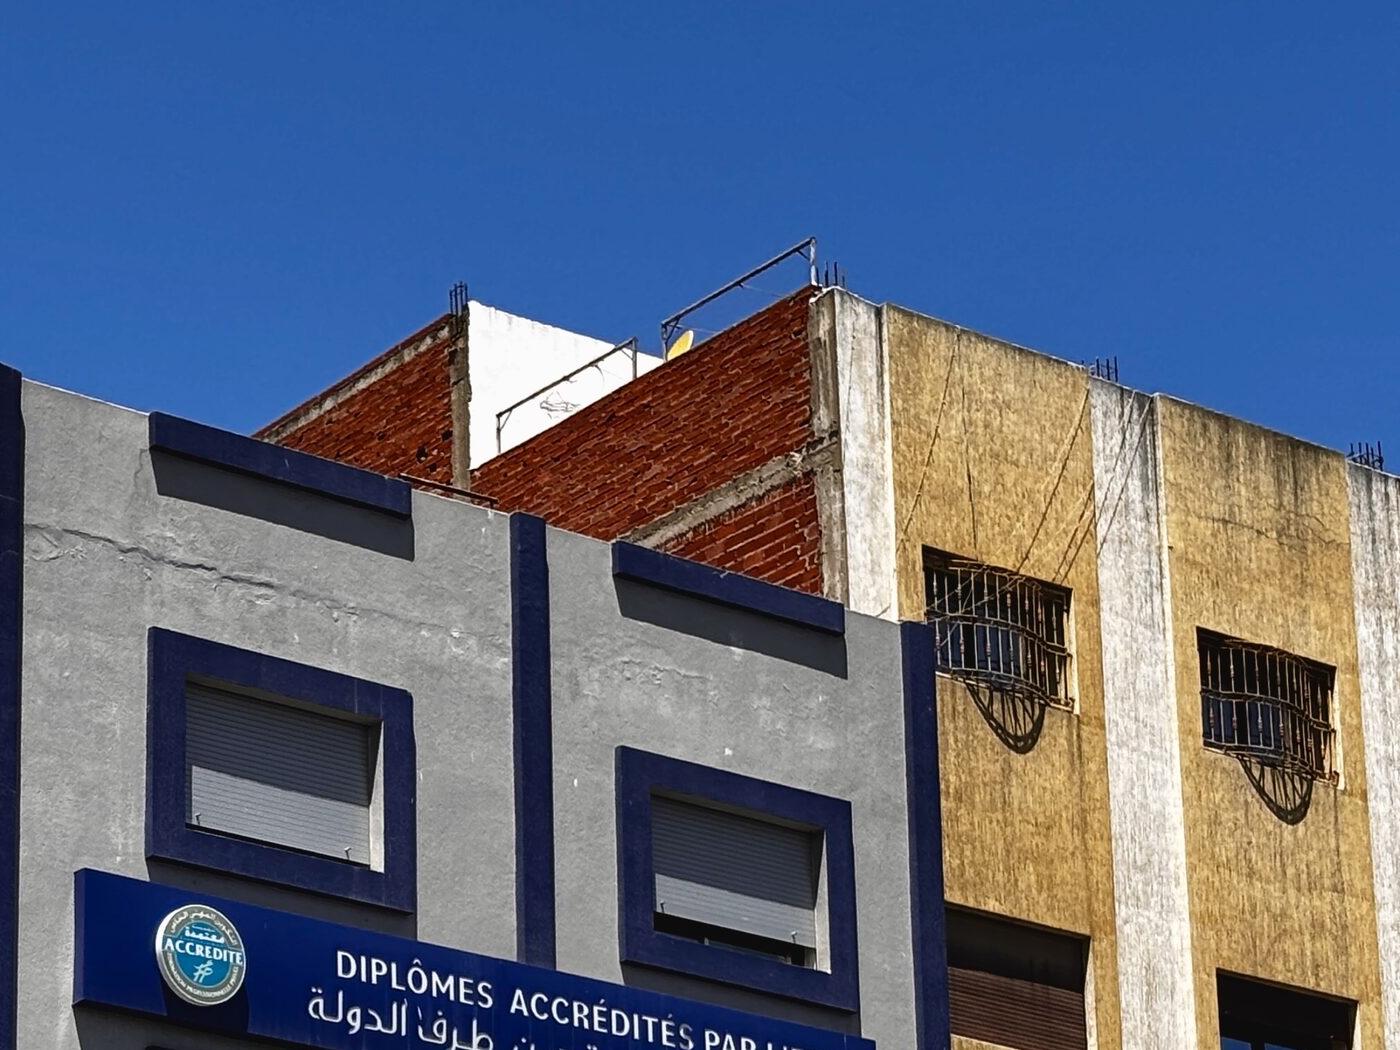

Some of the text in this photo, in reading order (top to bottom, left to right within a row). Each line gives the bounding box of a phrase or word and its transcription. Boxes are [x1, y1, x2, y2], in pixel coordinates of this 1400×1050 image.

[164, 938, 243, 965] ACCREDITE
[308, 986, 408, 1037] الدولة
[337, 950, 493, 1009] DIPLÔMES
[509, 988, 694, 1050] ACCRÉDITÉS
